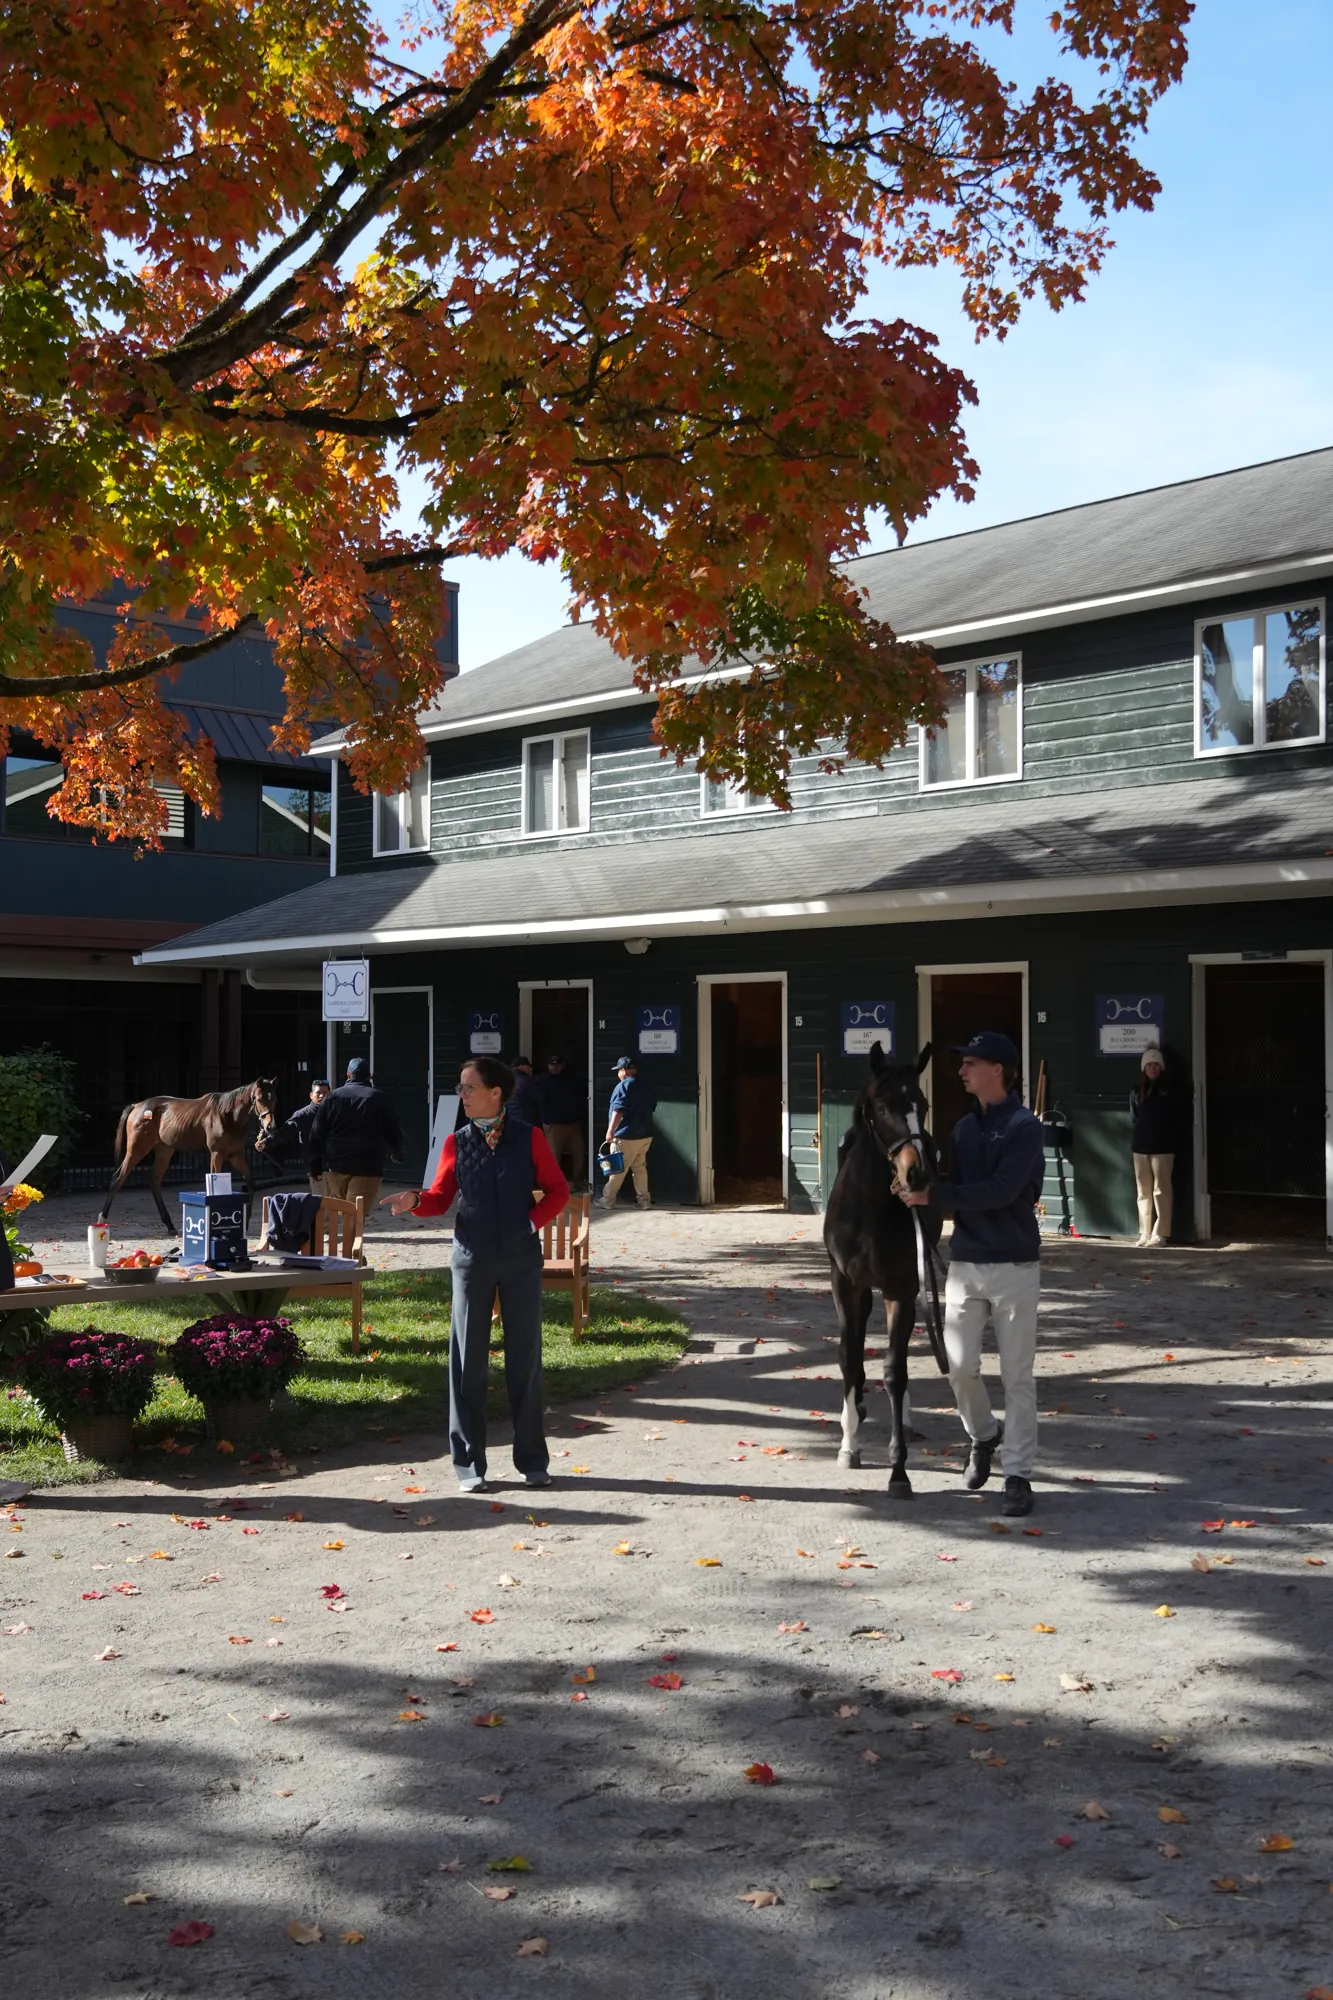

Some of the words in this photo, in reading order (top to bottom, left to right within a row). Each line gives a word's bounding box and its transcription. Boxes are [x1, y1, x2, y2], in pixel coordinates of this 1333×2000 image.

[794, 1016, 803, 1027] 15
[1037, 1011, 1047, 1023] 16
[598, 1020, 606, 1029] 14
[1121, 1028, 1136, 1036] 200
